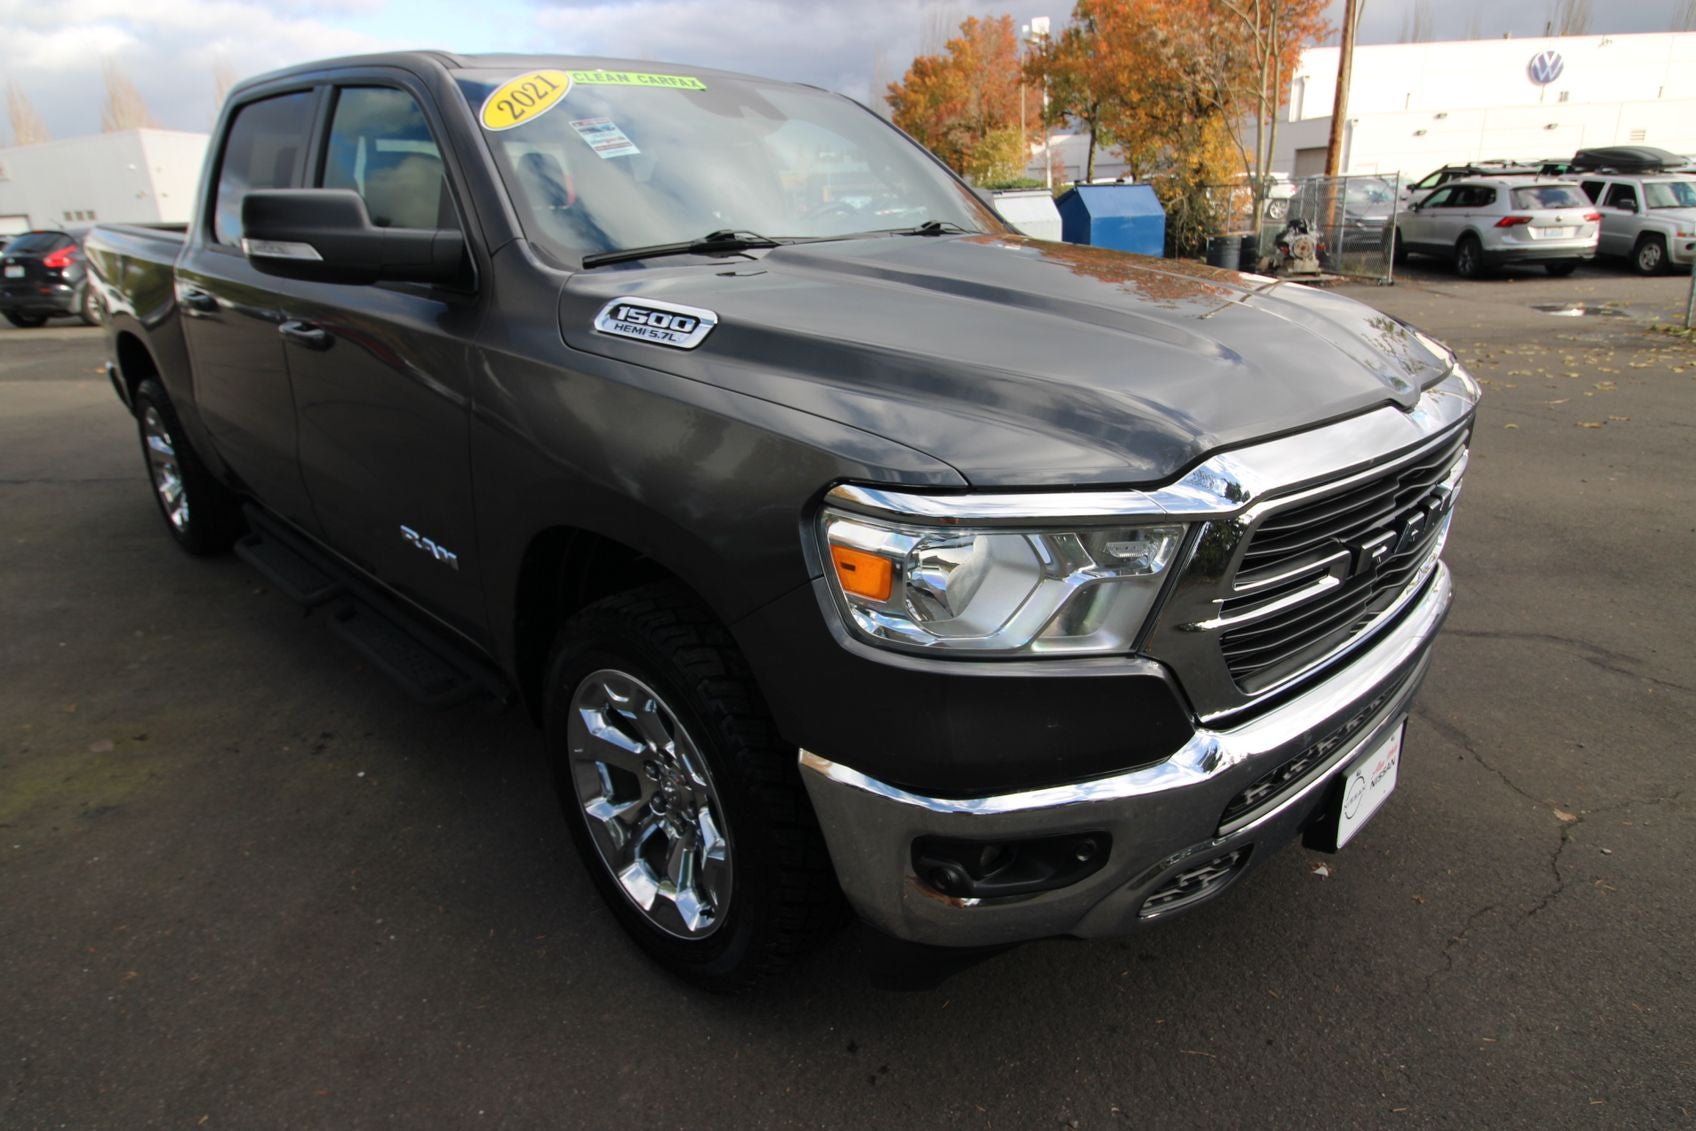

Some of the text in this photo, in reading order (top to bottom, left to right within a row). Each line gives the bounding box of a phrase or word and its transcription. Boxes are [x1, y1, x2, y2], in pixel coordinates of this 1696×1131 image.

[572, 72, 700, 88] CLEAN CARFAX
[497, 74, 560, 120] 2021
[617, 306, 697, 333] 1500
[614, 323, 677, 342] HEMI 5.7L
